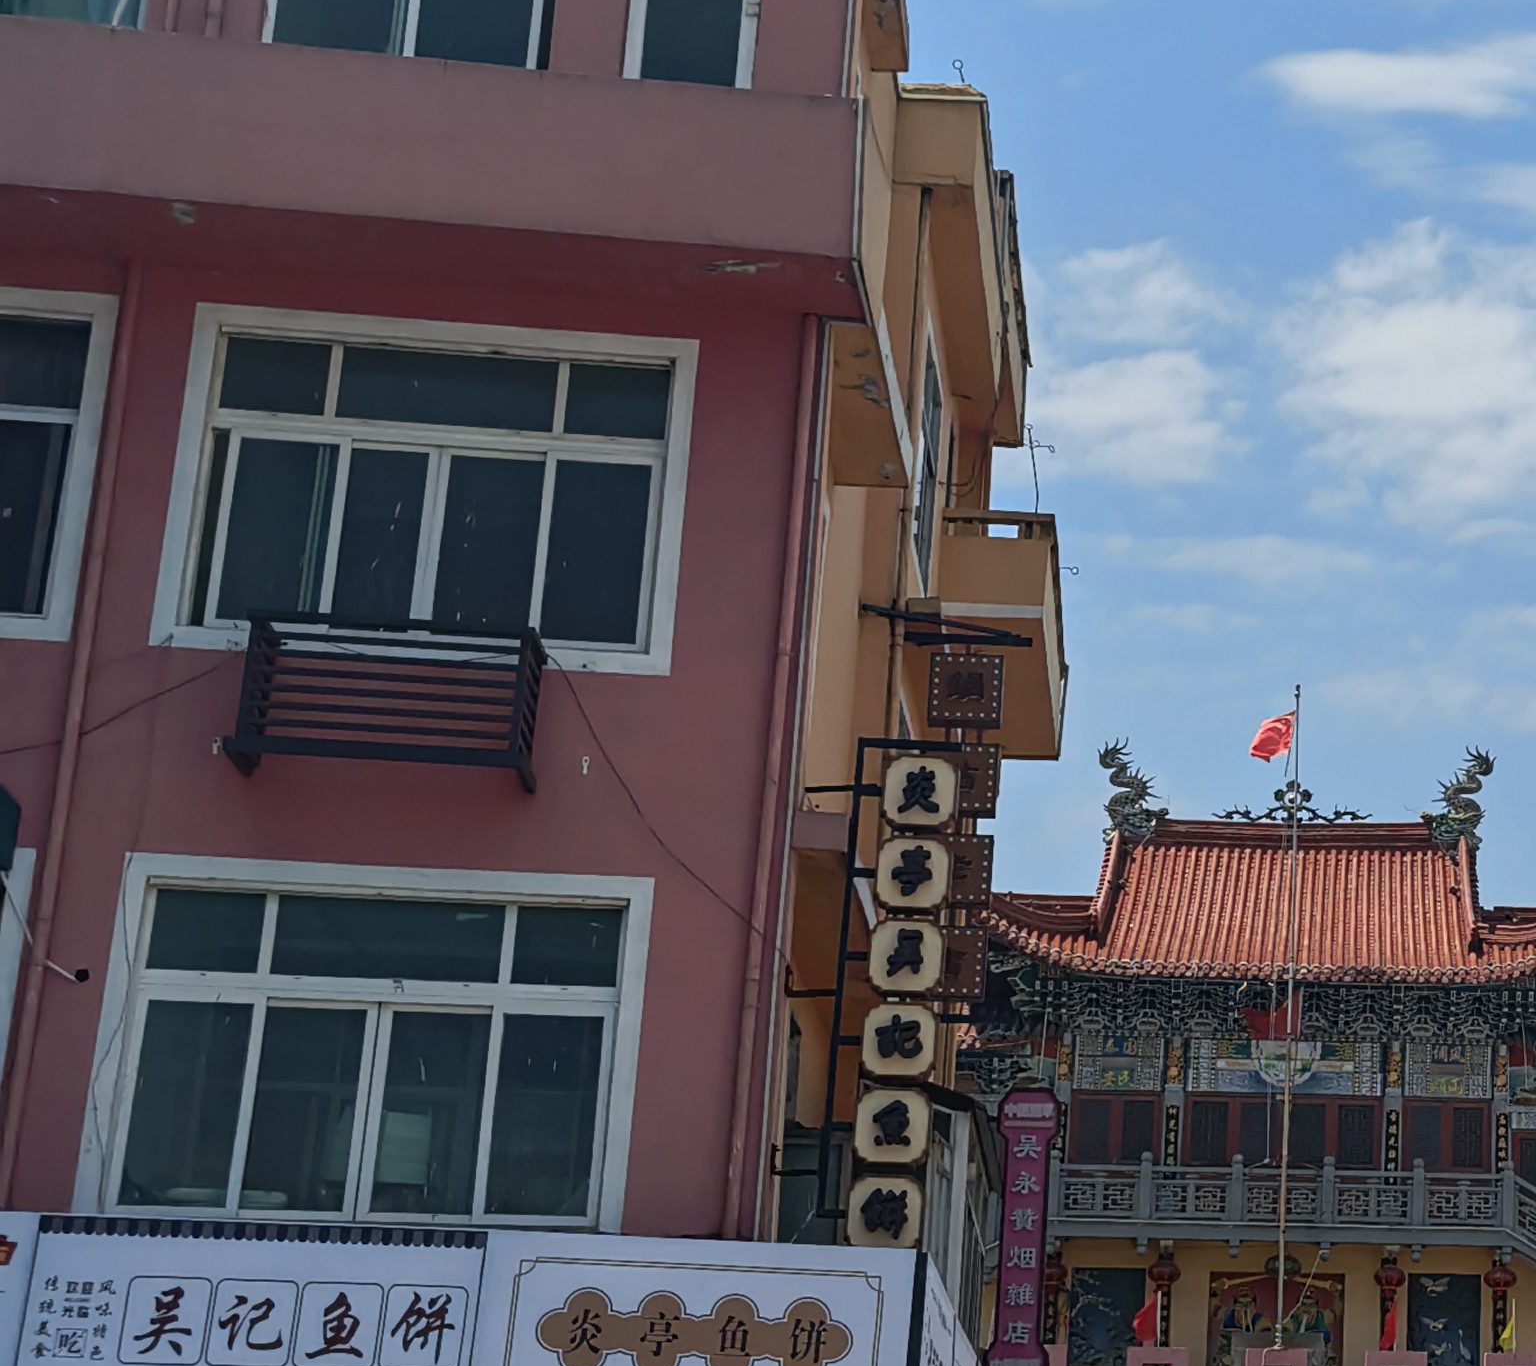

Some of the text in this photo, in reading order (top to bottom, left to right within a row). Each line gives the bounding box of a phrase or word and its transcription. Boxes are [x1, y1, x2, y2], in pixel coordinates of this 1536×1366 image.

[133, 1285, 457, 1366] 吴记鱼饼
[567, 1310, 829, 1366] 炎亭鱼饼
